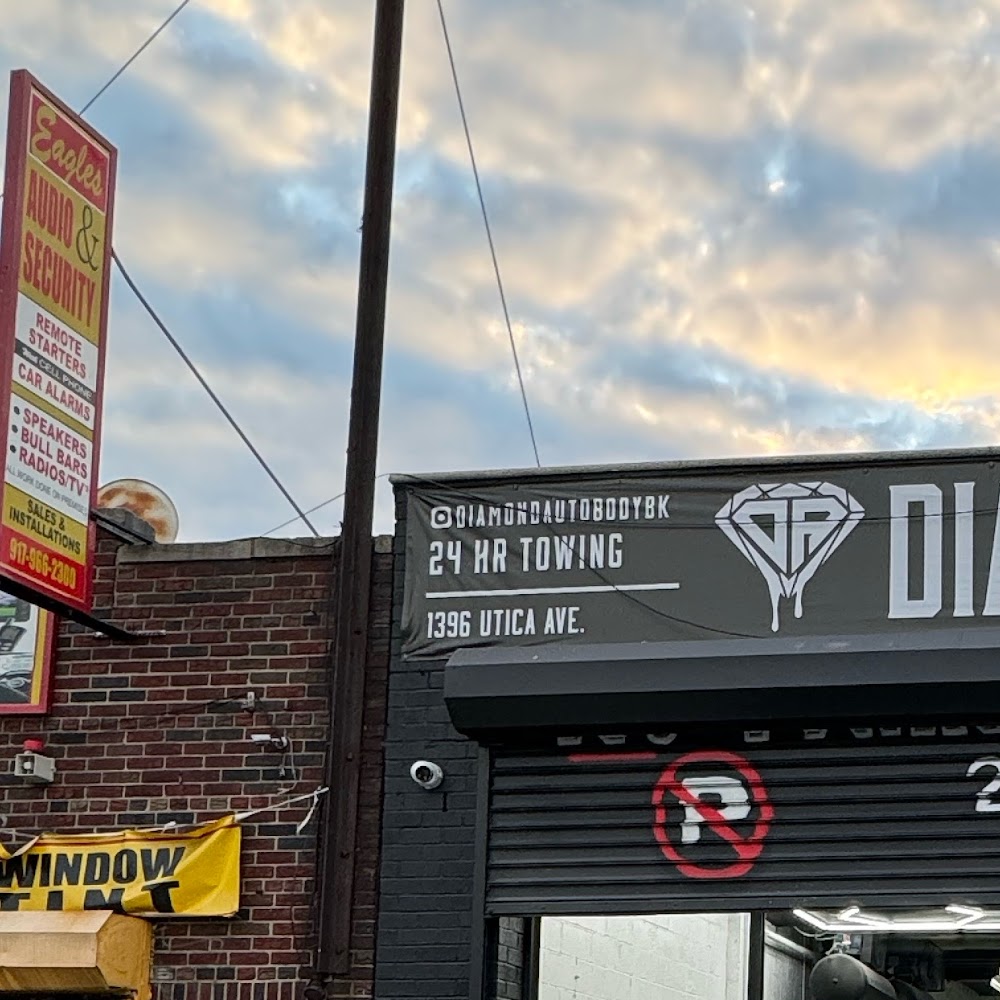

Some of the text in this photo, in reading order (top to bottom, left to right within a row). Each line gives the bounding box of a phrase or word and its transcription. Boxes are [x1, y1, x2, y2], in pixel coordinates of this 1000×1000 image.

[32, 105, 103, 196] Eagles
[26, 169, 99, 271] AUDIO &
[23, 230, 96, 327] SECURITY
[29, 328, 86, 379] STARTERS
[36, 312, 82, 357] REMOTE
[18, 362, 90, 421] CAR ALARMS
[21, 426, 87, 479] BULL BARS
[23, 408, 87, 459] SPEAKERS
[9, 506, 81, 555] INSTALLATIONS
[27, 499, 65, 531] SALES &
[429, 532, 623, 576] 24 HR TOWING
[427, 606, 585, 639] 1396 UTICA AVE.
[0, 846, 186, 888] WINDOW
